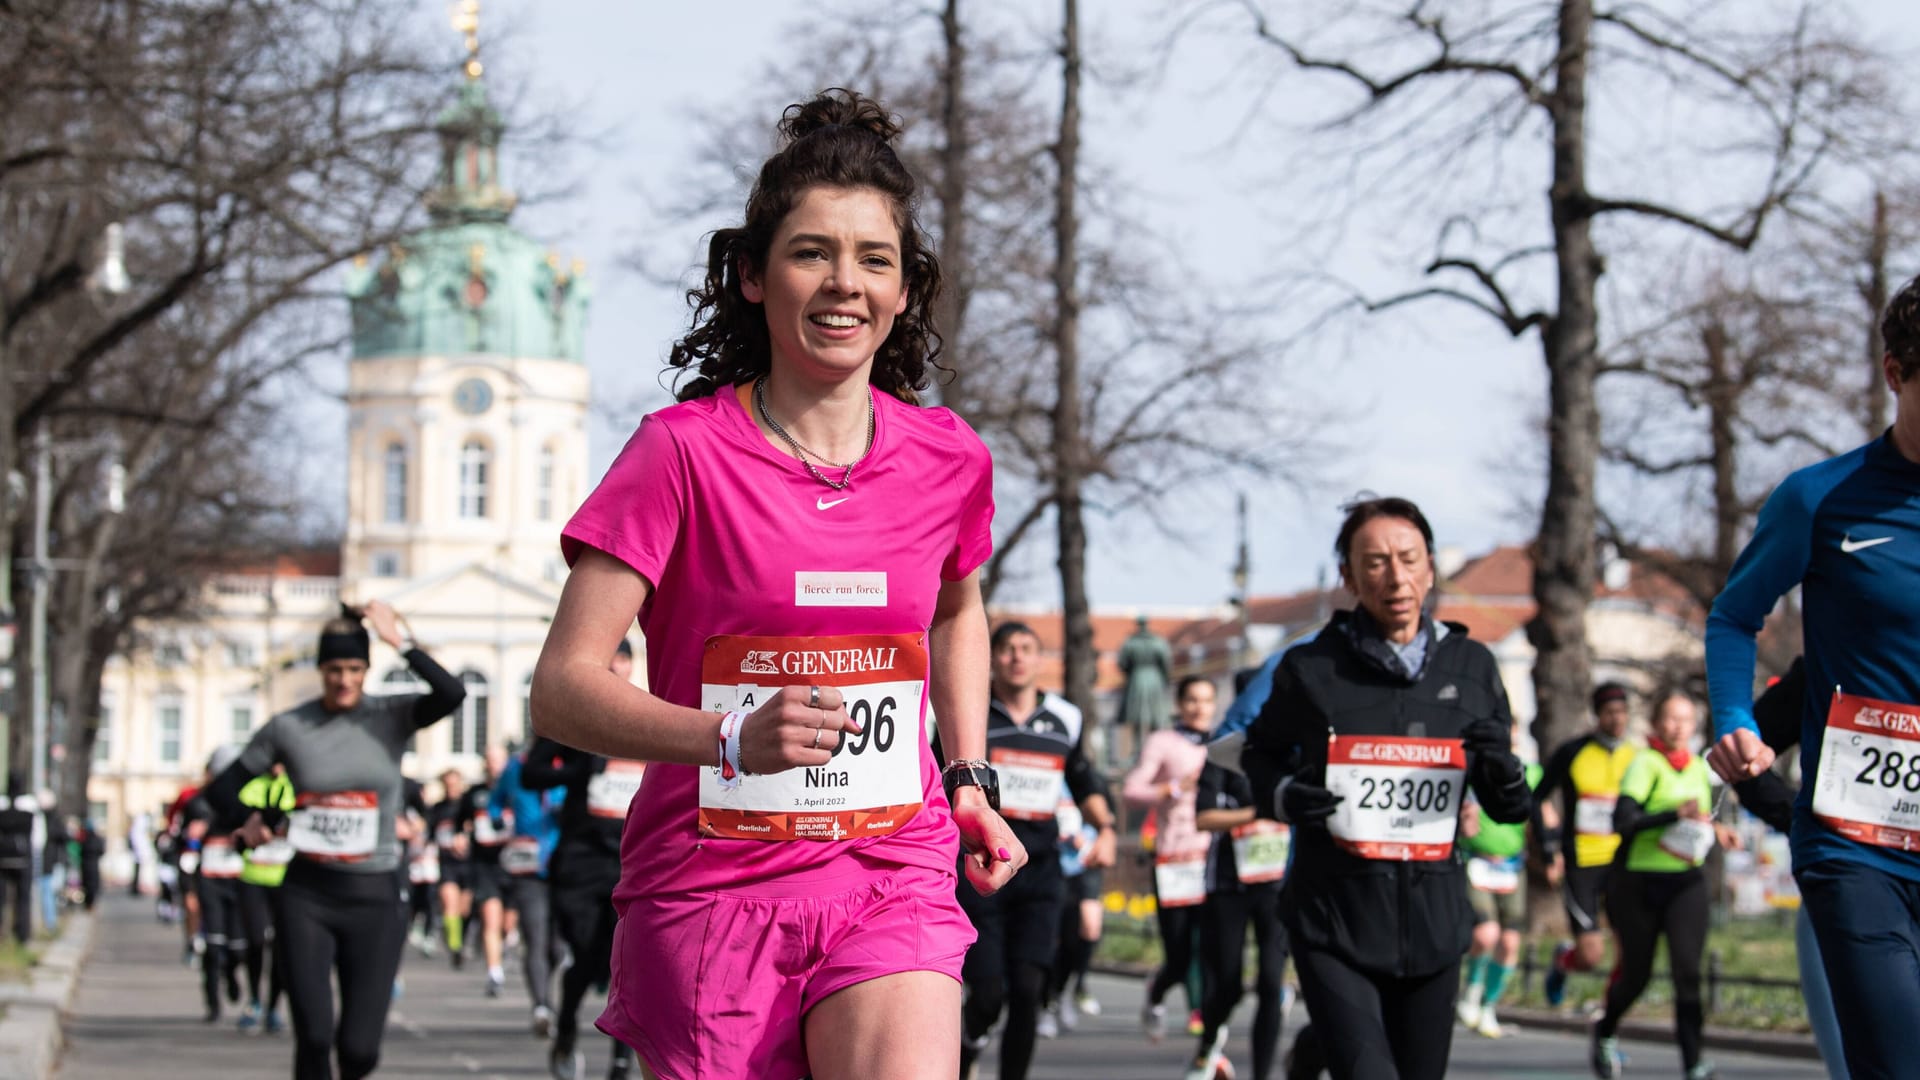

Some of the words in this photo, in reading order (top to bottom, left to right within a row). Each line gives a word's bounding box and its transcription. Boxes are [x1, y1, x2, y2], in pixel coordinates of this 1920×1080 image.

[804, 584, 831, 594] fierce
[835, 586, 852, 594] run
[856, 584, 884, 594] force.
[782, 648, 897, 675] GENERALI
[741, 692, 755, 707] A
[1852, 735, 1862, 746] C
[1374, 743, 1451, 763] GENERALI
[805, 767, 849, 788] Nina
[1358, 778, 1451, 812] 23308
[794, 798, 802, 806] 3.
[804, 798, 825, 808] April
[826, 797, 846, 806] 2022
[1892, 798, 1919, 815] Jan
[737, 824, 771, 833] #berlinhalf
[795, 823, 828, 831] BERLINER
[867, 820, 893, 830] #berlinhalf
